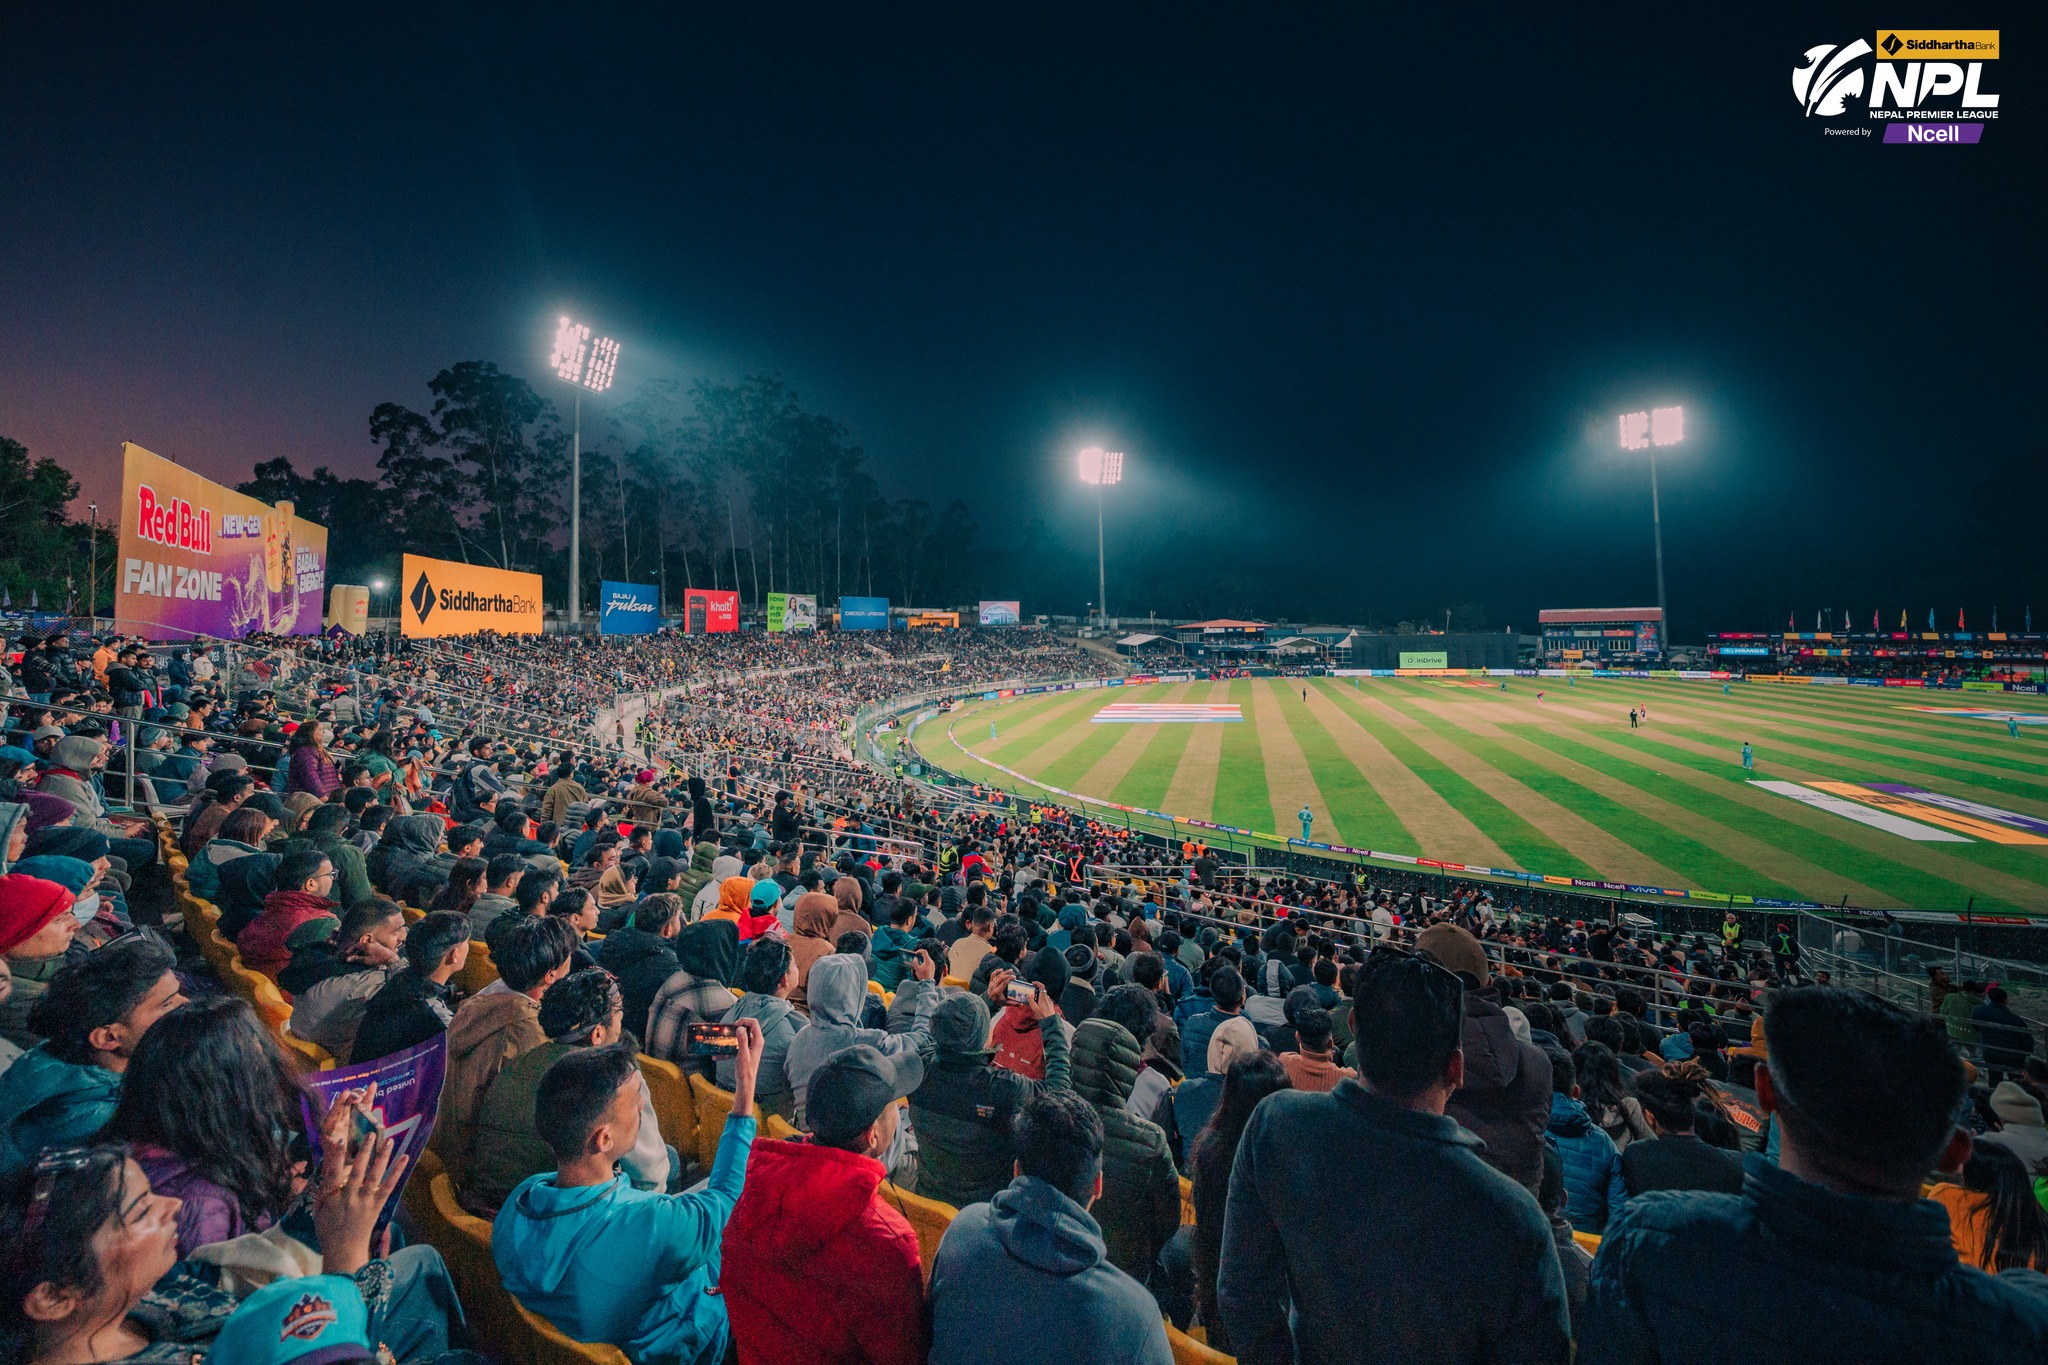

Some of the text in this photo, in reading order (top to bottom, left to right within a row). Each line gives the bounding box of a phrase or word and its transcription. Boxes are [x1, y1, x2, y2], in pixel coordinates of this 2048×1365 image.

[137, 483, 212, 556] Red Bull
[123, 557, 223, 601] FAN ZONE
[612, 592, 631, 600] BAJAJ
[710, 600, 733, 612] khalti
[2012, 684, 2038, 692] Ncell
[1330, 845, 1347, 853] Ncell
[1574, 879, 1597, 887] Ncell
[1603, 882, 1626, 890] Ncell
[1631, 886, 1658, 894] vivo
[386, 1077, 416, 1095] United
